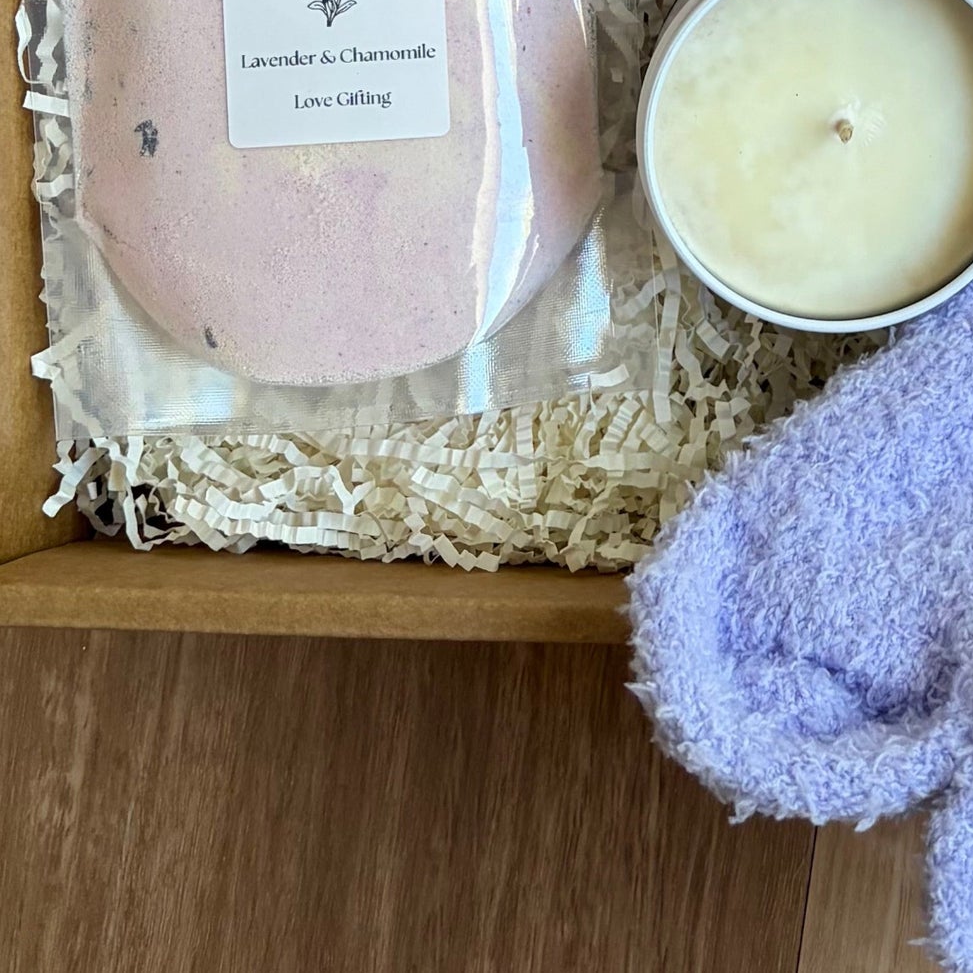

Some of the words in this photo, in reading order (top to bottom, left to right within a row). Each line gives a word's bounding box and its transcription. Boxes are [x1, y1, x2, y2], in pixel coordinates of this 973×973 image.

[241, 50, 316, 69] Lavender
[320, 50, 336, 65] &
[339, 43, 436, 64] Chamomile
[294, 93, 332, 109] Love
[336, 89, 392, 109] Gifting
